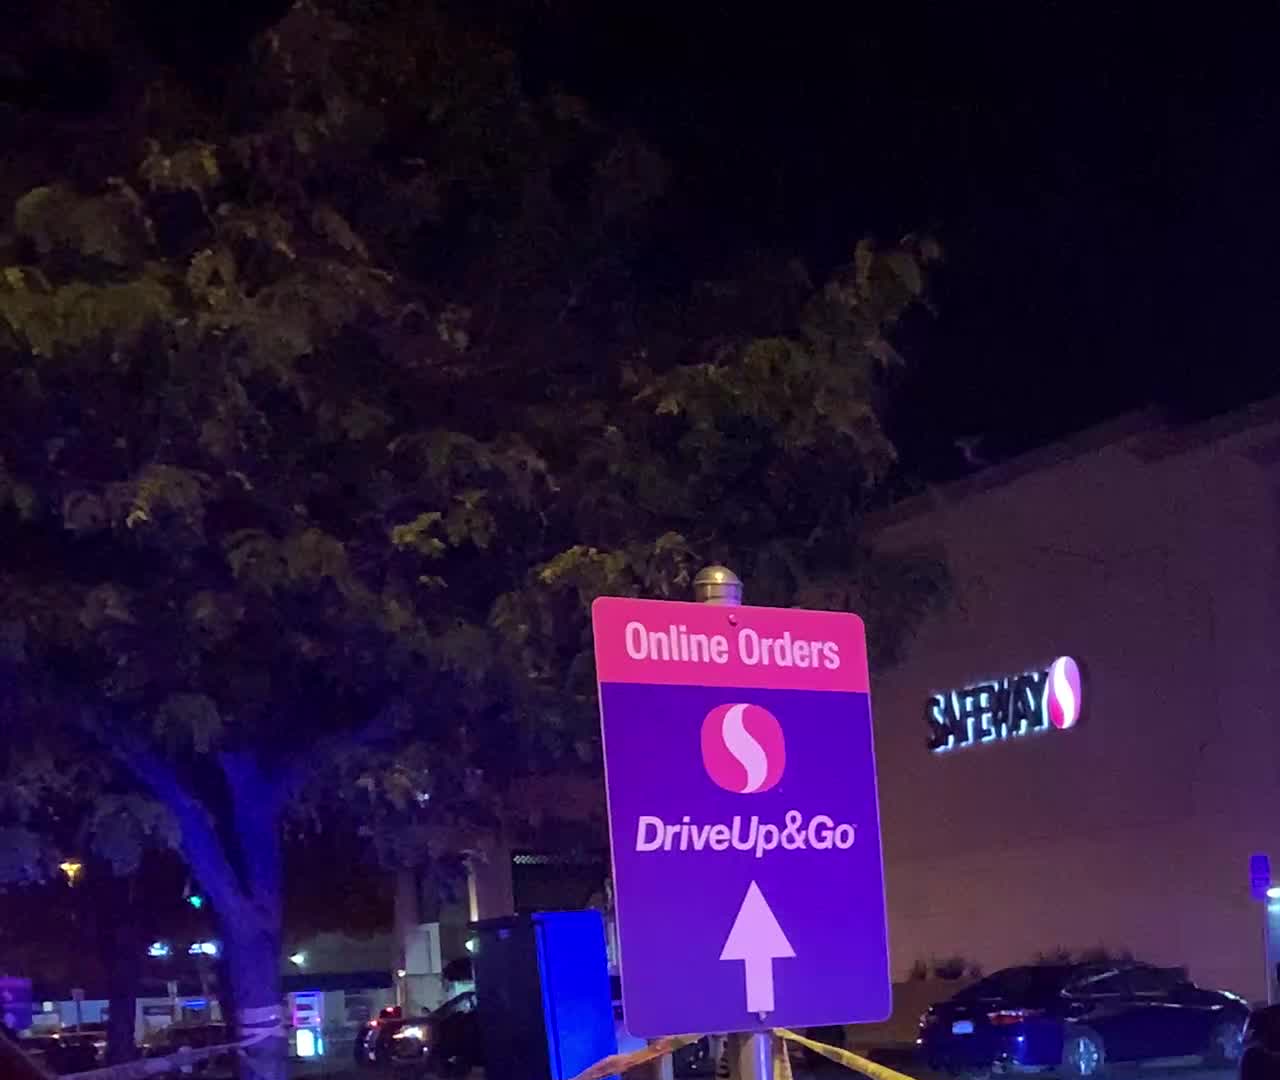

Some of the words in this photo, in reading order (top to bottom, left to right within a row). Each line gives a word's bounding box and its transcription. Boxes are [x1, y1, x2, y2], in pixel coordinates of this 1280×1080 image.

[625, 620, 730, 664] Online
[738, 627, 841, 670] Orders
[927, 669, 1050, 752] SAFEWAY
[635, 810, 856, 858] DriveUp&Go
